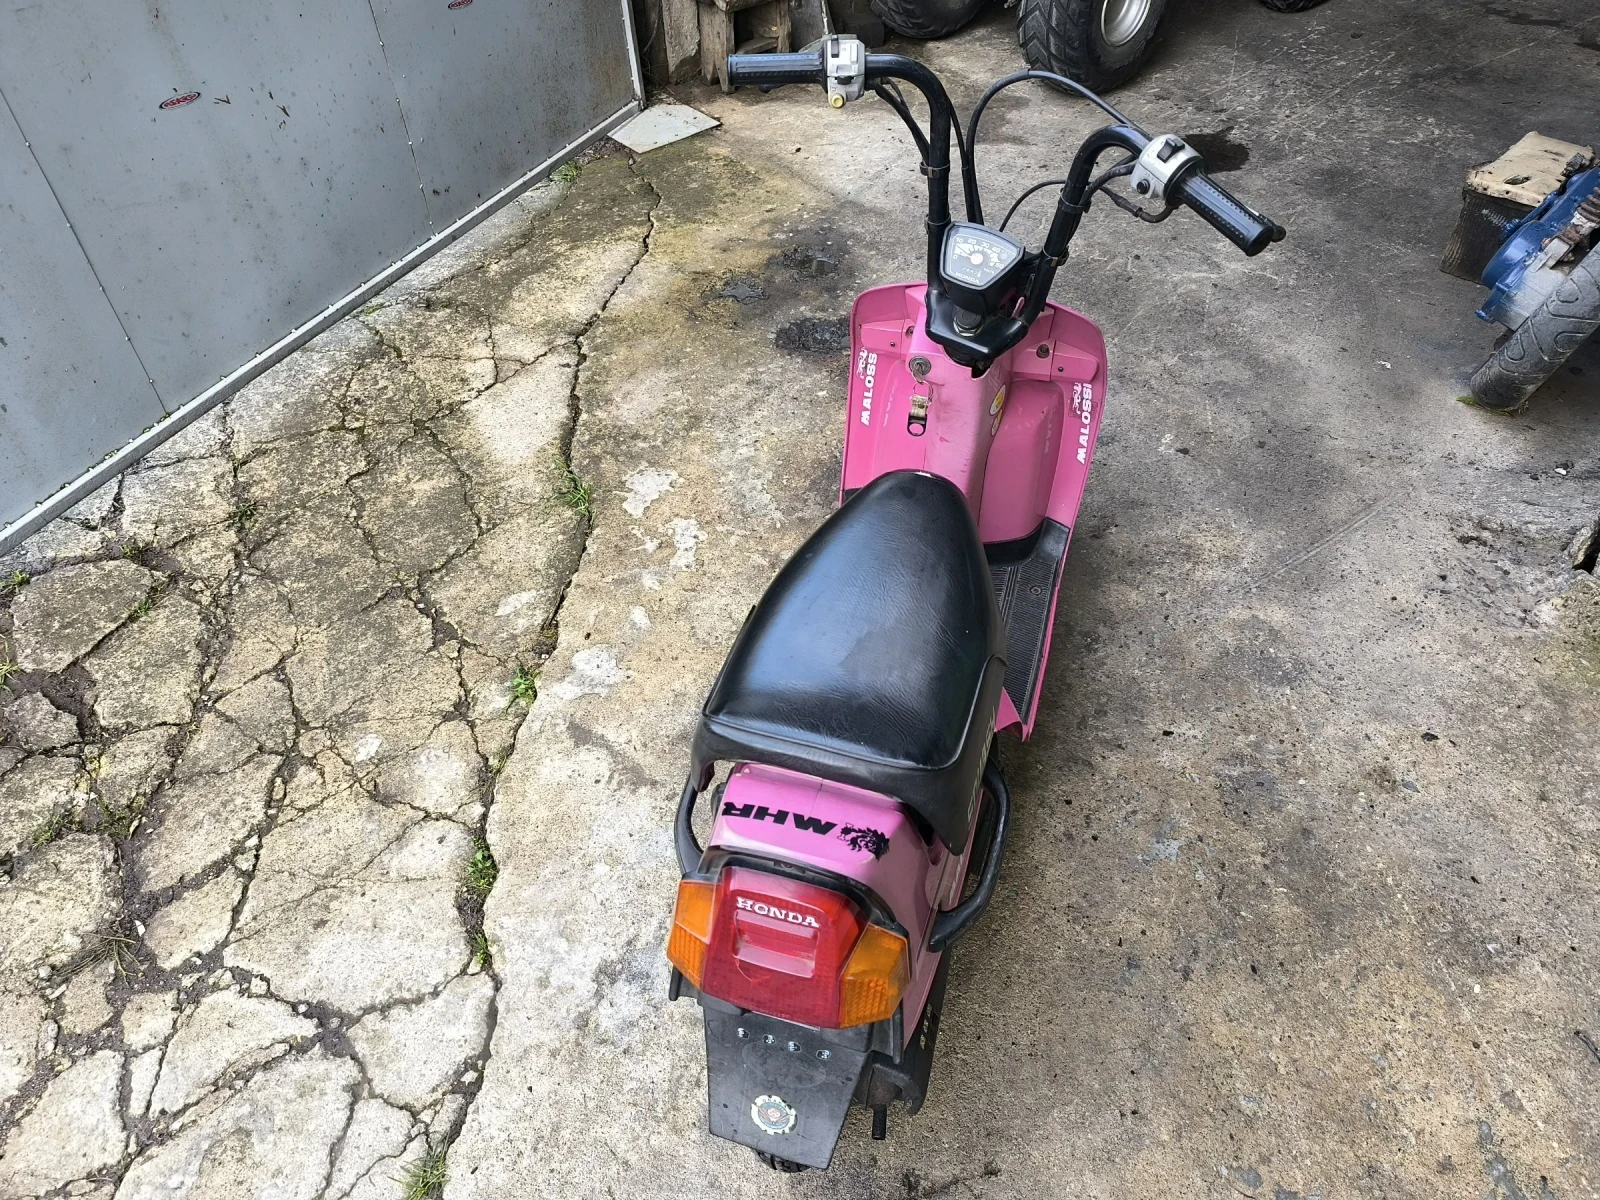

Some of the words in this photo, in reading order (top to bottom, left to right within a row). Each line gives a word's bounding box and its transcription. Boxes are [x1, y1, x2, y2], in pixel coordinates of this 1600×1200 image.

[1076, 382, 1092, 465] MALOSSI
[721, 801, 838, 836] MHR
[735, 895, 821, 928] HONDA
